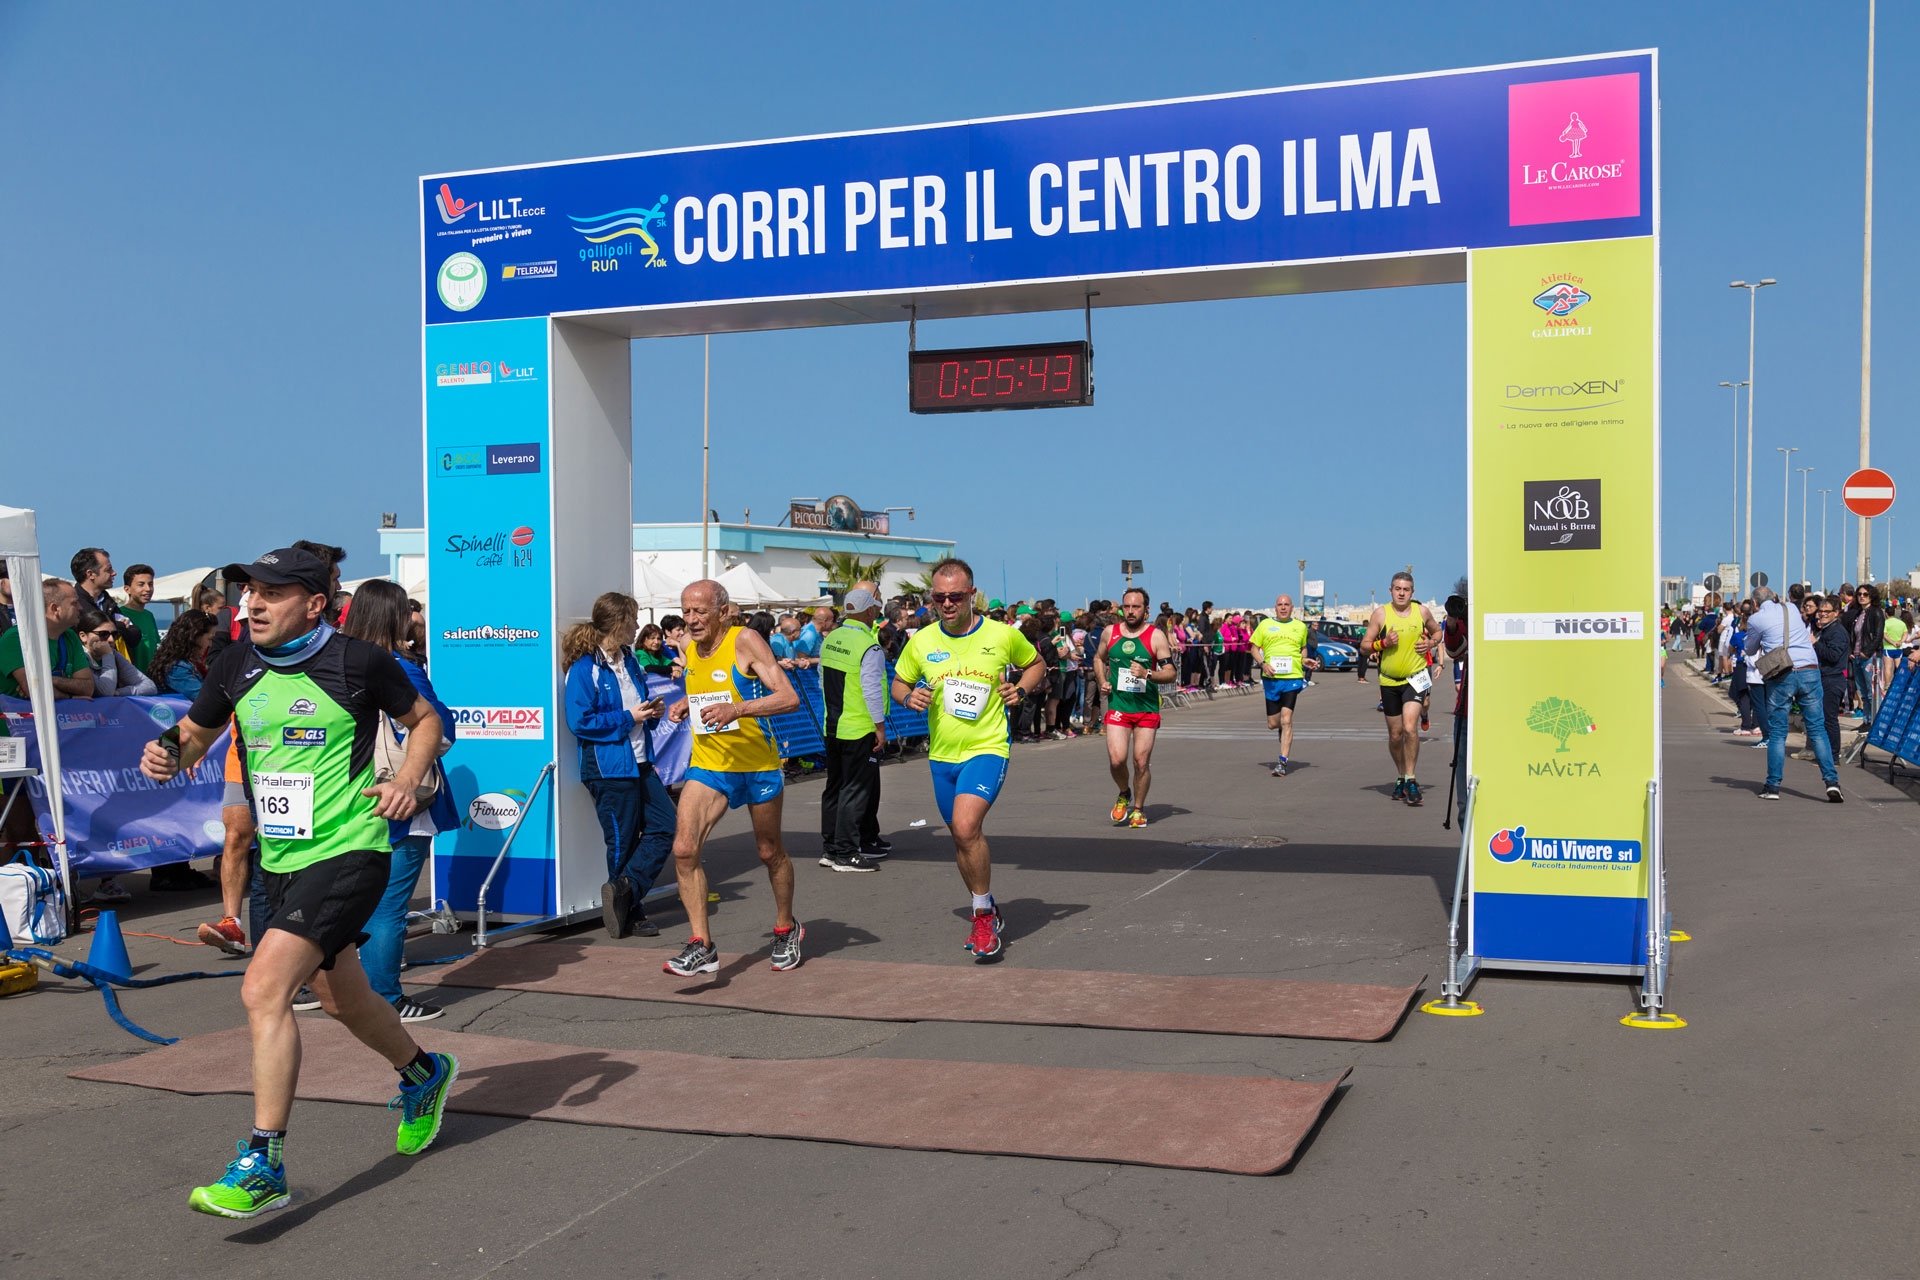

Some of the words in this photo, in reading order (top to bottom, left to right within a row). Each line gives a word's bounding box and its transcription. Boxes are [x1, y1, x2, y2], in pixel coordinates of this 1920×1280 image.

[673, 184, 826, 265] CORRI
[844, 174, 948, 252] PER
[965, 168, 1013, 243] IL
[1028, 143, 1262, 238] CENTRO
[1282, 127, 1442, 217] ILMA
[479, 197, 522, 222] LILT
[517, 206, 546, 218] LECCE
[656, 218, 667, 228] 5k
[579, 242, 632, 262] gallipoli
[516, 265, 554, 276] TELERAMA
[652, 258, 667, 268] 10k
[1540, 272, 1584, 287] Atletica
[1545, 318, 1579, 328] ANXA
[1531, 326, 1593, 339] GALLIPOLI
[435, 360, 492, 377] GENEO
[514, 366, 535, 378] LILT
[439, 376, 466, 385] SALENTO
[938, 354, 1074, 399] 0:25:43
[1506, 422, 1517, 430] La
[1519, 422, 1543, 430] nuova
[1600, 418, 1625, 426] intima
[492, 453, 535, 466] Leverano
[794, 510, 834, 528] PICCOLO
[860, 517, 882, 531] LIDO
[445, 531, 507, 559] Spinelli
[965, 666, 995, 682] Lecce
[1125, 676, 1139, 685] 245
[953, 692, 977, 706] 352
[305, 728, 325, 740] GLS
[465, 729, 517, 737] www.idrovelox.it
[69, 769, 104, 795] PER
[261, 775, 311, 791] Kalenji
[260, 796, 290, 815] 163
[472, 800, 519, 818] Fiorucci
[106, 835, 149, 851] GENEO
[1531, 839, 1558, 859] Noi
[1561, 839, 1613, 861] Vivere
[1617, 847, 1633, 861] srl
[1531, 861, 1566, 870] Raccolta
[1568, 862, 1608, 871] Indumenti
[1611, 863, 1633, 872] Usati
